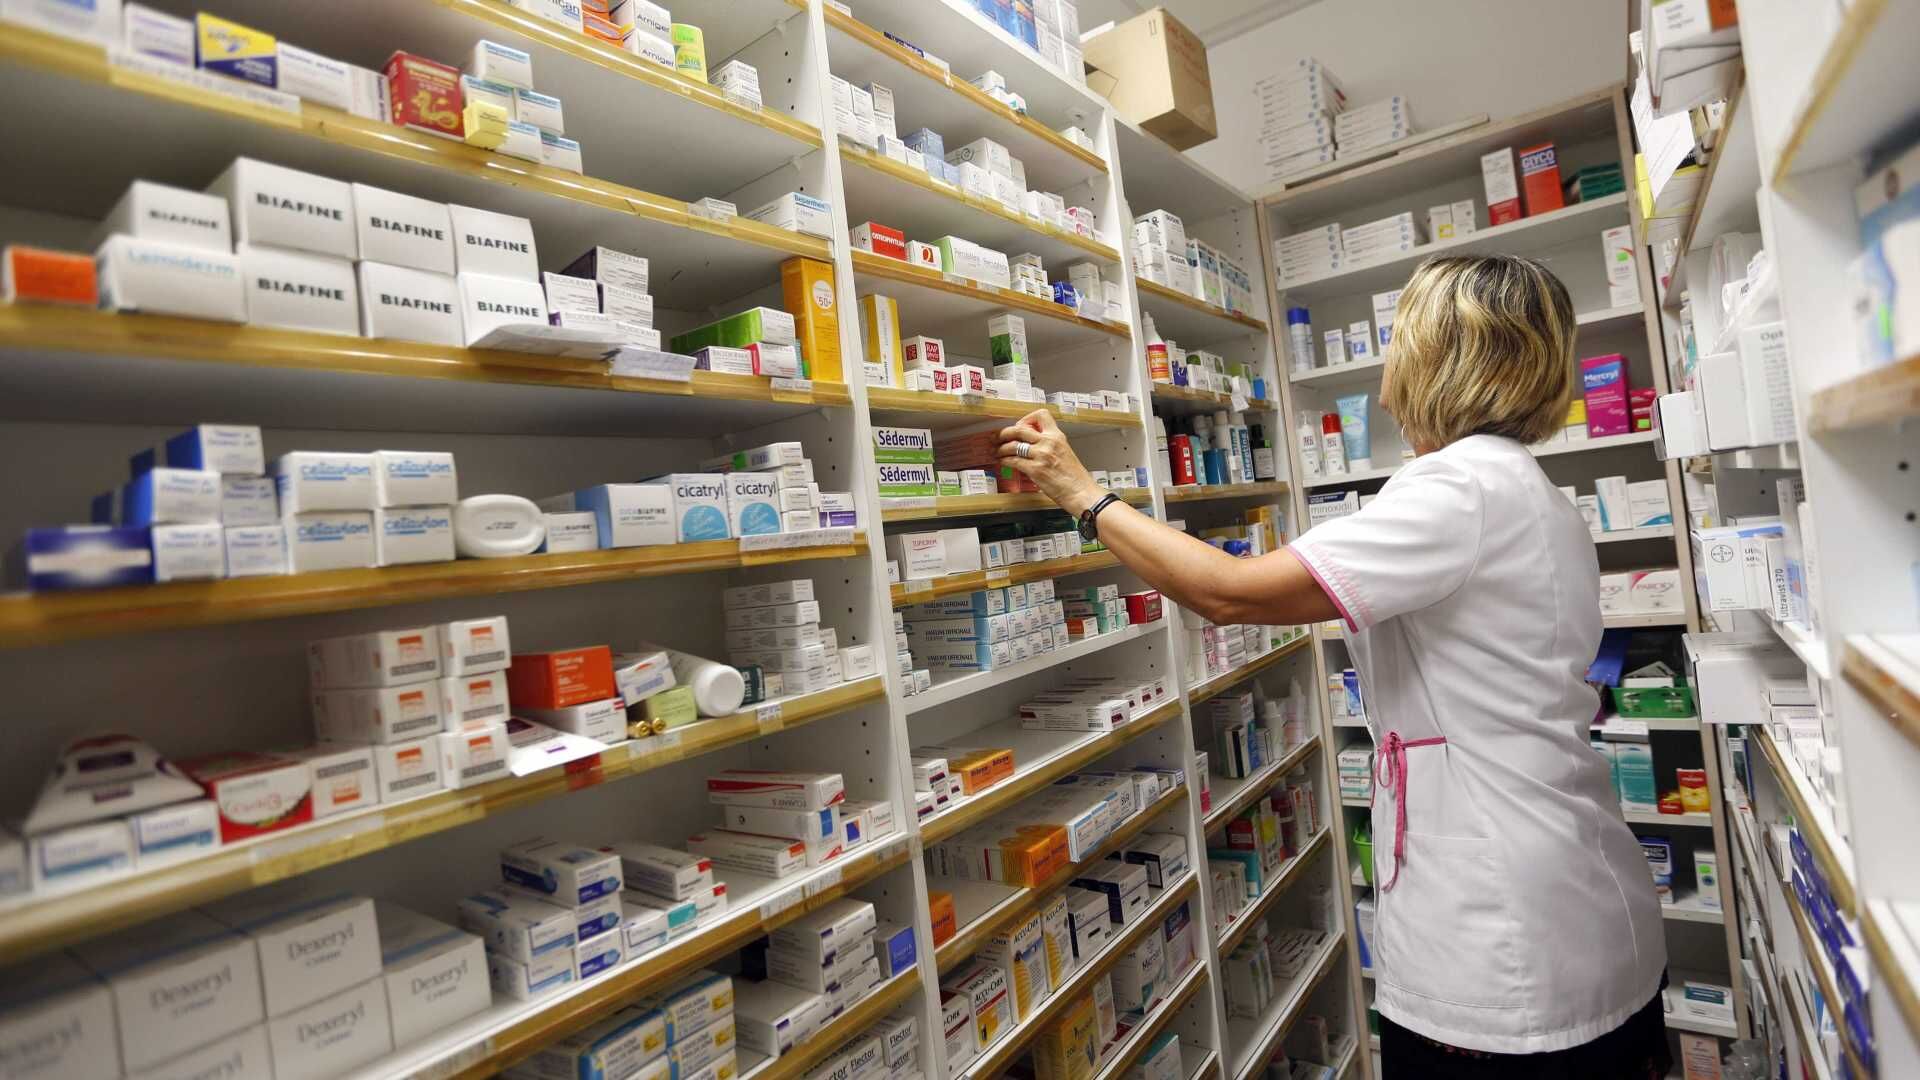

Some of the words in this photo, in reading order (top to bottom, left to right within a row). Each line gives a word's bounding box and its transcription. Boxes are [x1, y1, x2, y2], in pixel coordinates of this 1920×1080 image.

[256, 192, 343, 221] BIAFINE
[149, 209, 219, 230] BIAFINE
[370, 216, 444, 241] BIAFINE
[465, 234, 529, 254] BIAFINE
[257, 277, 345, 301] BIAFINE
[380, 293, 452, 314] BIAFINE
[477, 300, 540, 318] BIAFINE
[878, 428, 929, 450] Sédermyl
[879, 466, 931, 485] Sédermyl
[677, 483, 725, 500] cicatryl
[735, 482, 777, 498] cicatryl
[1774, 568, 1784, 583] 370
[1777, 584, 1789, 618] Ultravist
[288, 922, 355, 962] Dexeryl
[149, 965, 233, 1009] Dexeryl
[411, 959, 469, 996] Dexeryl
[297, 1001, 365, 1043] Dexeryl
[889, 1023, 912, 1047] Flector
[850, 1047, 876, 1070] Flector
